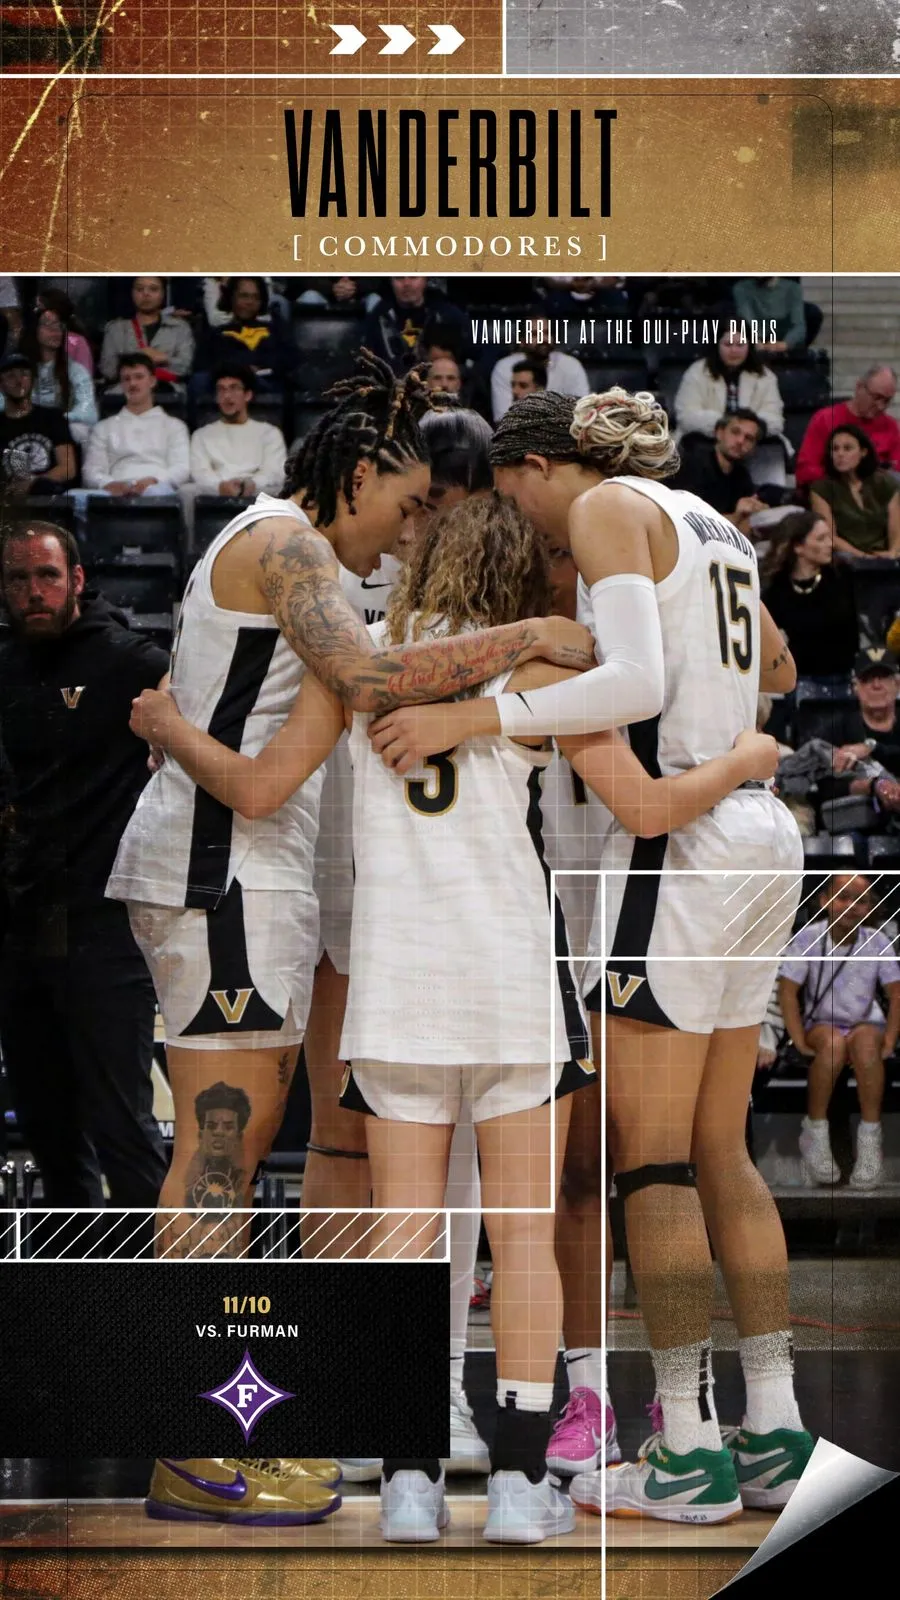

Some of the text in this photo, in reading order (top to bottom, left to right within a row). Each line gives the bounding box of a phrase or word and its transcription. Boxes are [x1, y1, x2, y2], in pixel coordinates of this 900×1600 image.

[709, 560, 752, 674] 15
[60, 686, 85, 709] V
[209, 987, 255, 1024] V
[605, 969, 646, 1008] V
